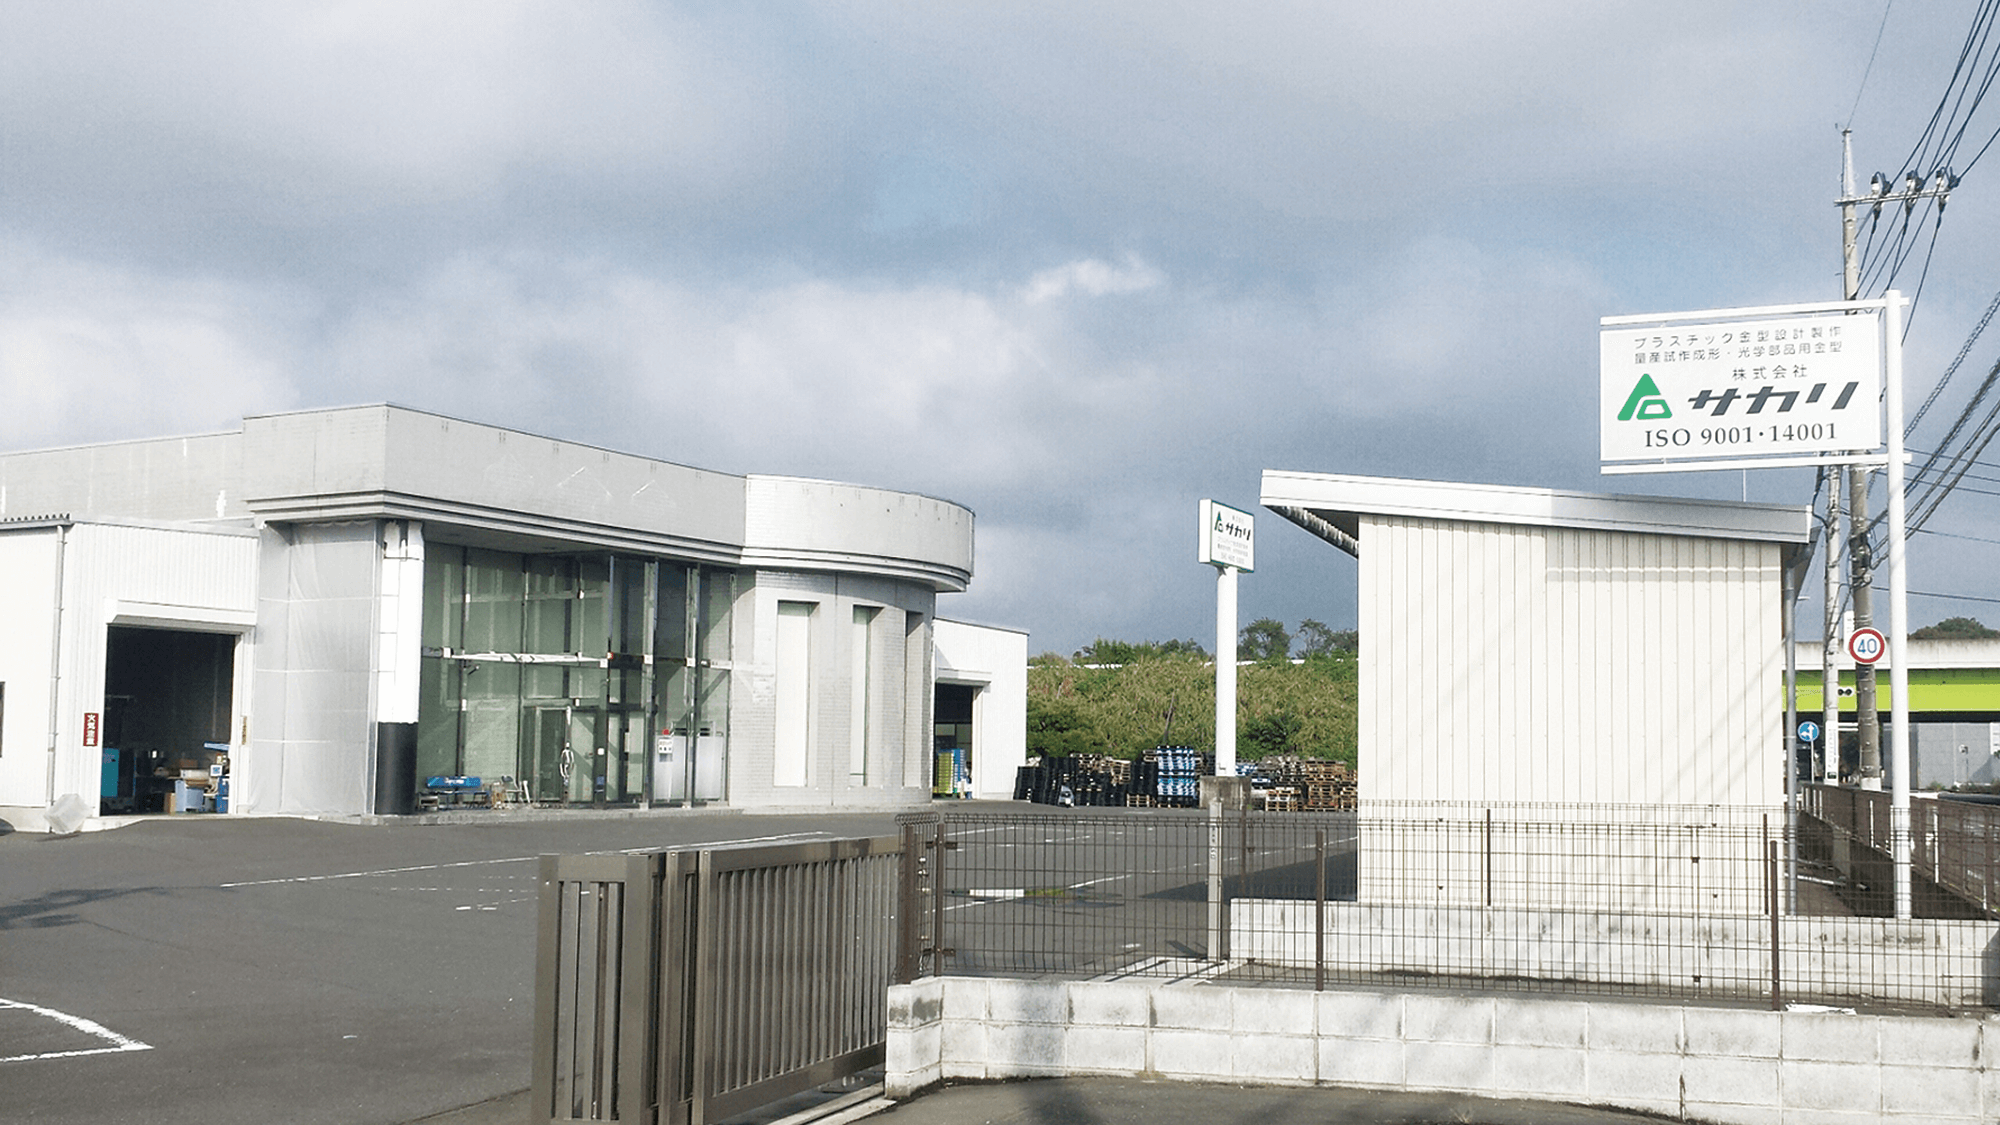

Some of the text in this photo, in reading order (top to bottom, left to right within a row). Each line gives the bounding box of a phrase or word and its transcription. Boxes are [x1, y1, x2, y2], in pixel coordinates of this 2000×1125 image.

[1634, 326, 1842, 350] プラスチック金型設計製作
[1634, 341, 1842, 365] 量産試作成形・光学部品用金型
[1732, 364, 1808, 381] 株式会社
[1687, 381, 1860, 417] サカリ
[1644, 428, 1691, 448] ISO
[1226, 523, 1251, 541] サカリ
[1857, 638, 1877, 654] 40
